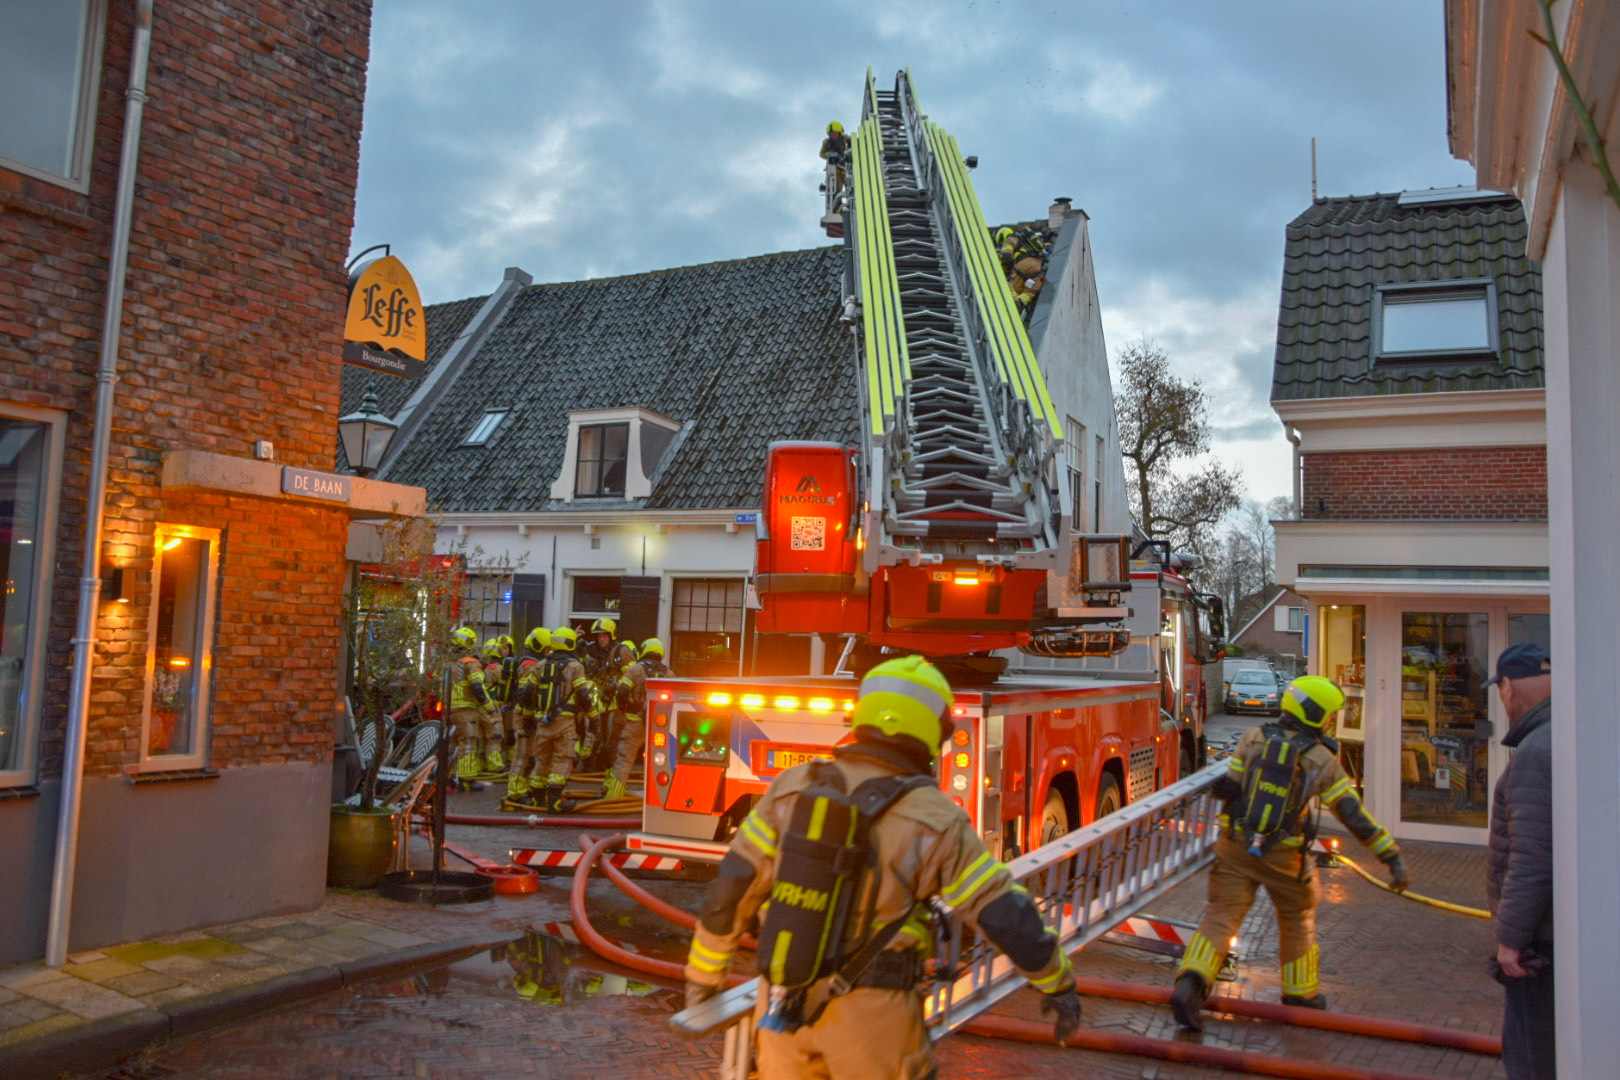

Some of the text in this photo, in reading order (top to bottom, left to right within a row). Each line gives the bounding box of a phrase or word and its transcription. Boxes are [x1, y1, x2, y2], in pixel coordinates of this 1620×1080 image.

[360, 283, 417, 337] Leffe
[362, 350, 407, 371] Bourgondie
[294, 474, 342, 496] DE BAAN
[780, 495, 835, 506] MAGIRUS
[772, 881, 828, 912] VRHM
